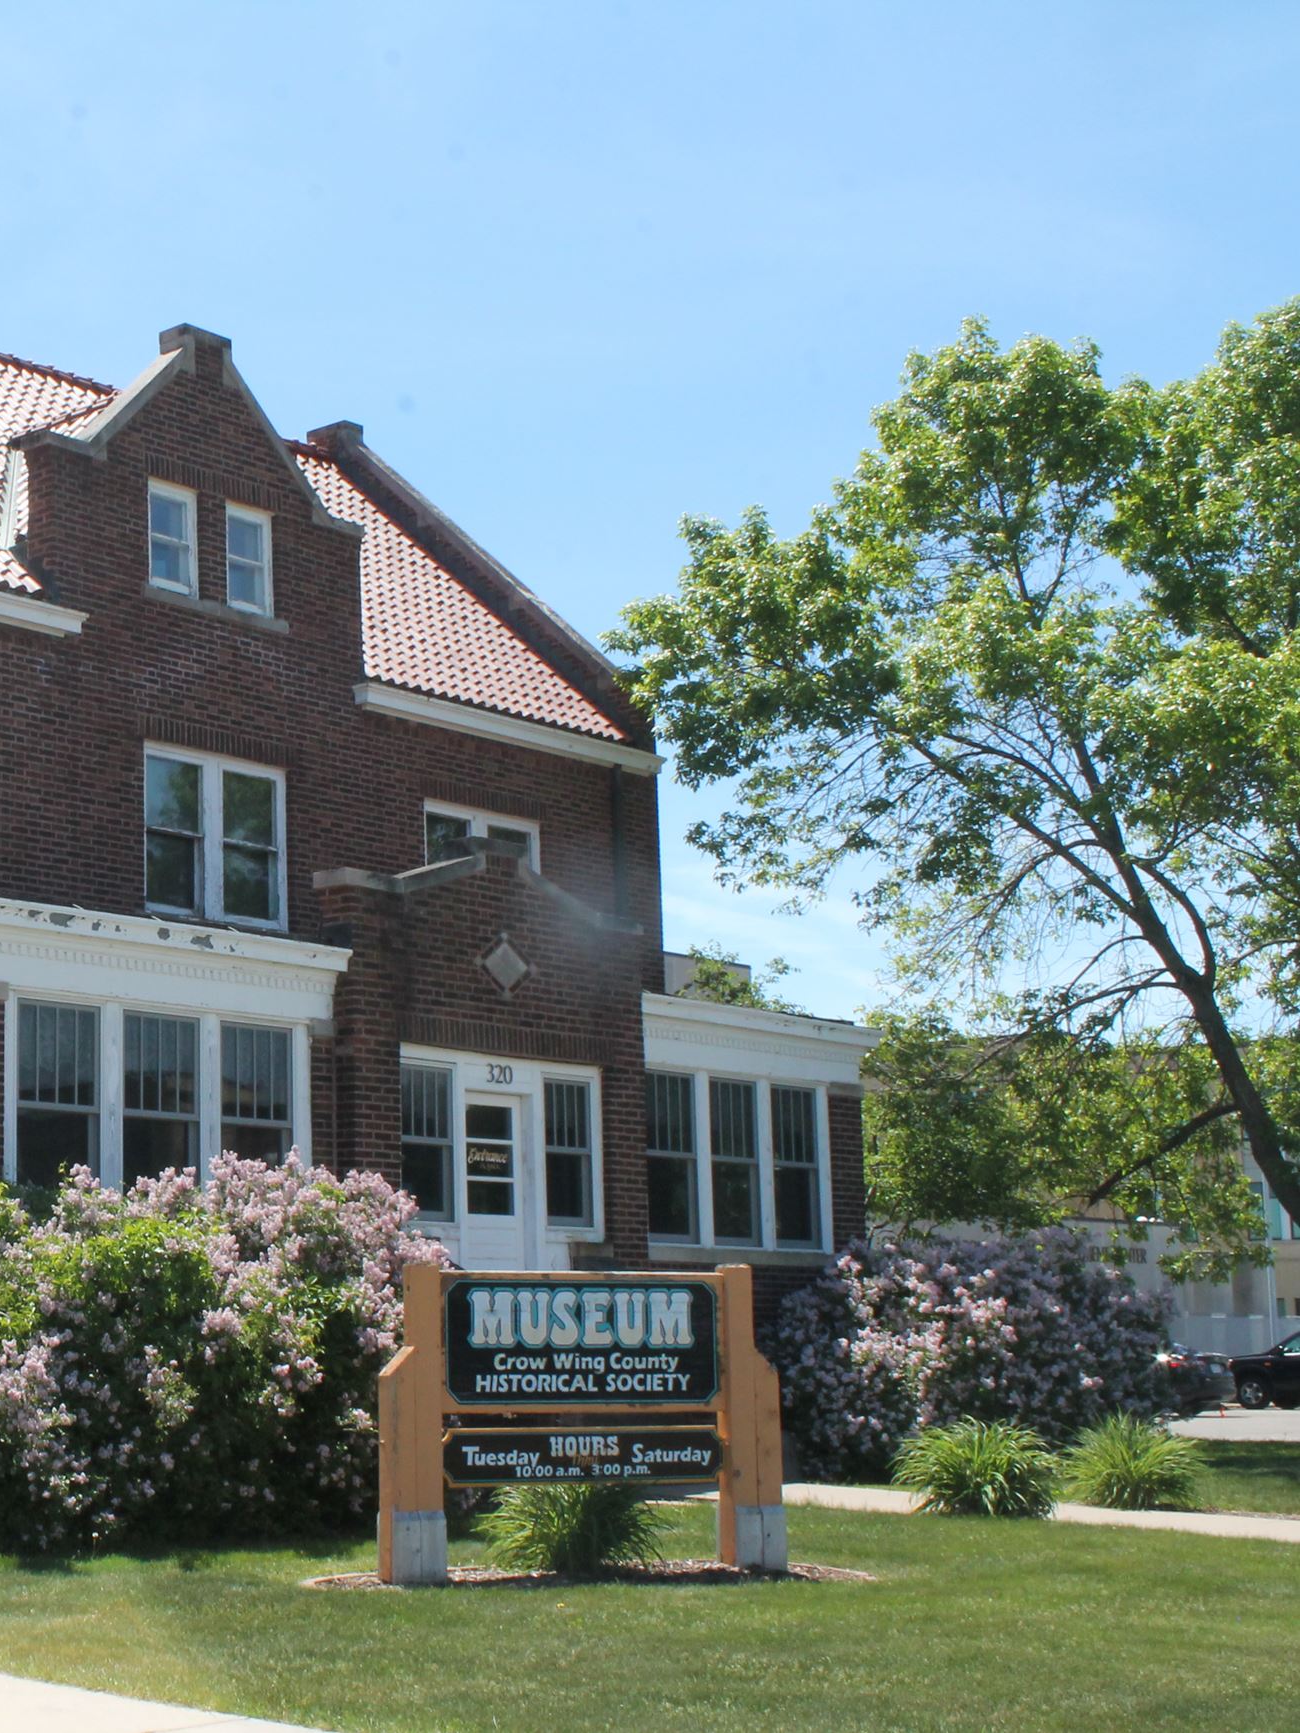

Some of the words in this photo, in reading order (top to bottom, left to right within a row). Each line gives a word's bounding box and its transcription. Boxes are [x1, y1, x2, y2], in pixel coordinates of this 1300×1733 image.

[486, 1063, 513, 1085] 320
[467, 1147, 508, 1164] Entrance
[467, 1287, 694, 1348] MUSEUM
[493, 1353, 547, 1371] Crow
[553, 1353, 605, 1373] Wing
[609, 1352, 679, 1372] County
[475, 1374, 598, 1393] HISTORICAL
[605, 1373, 690, 1392] SOCIETY
[461, 1445, 540, 1467] Tuesday
[631, 1443, 712, 1466] Saturday
[549, 1435, 619, 1457] HOURS
[556, 1465, 584, 1477] a.m.
[591, 1463, 621, 1476] 3:00
[623, 1465, 650, 1478] p.m.
